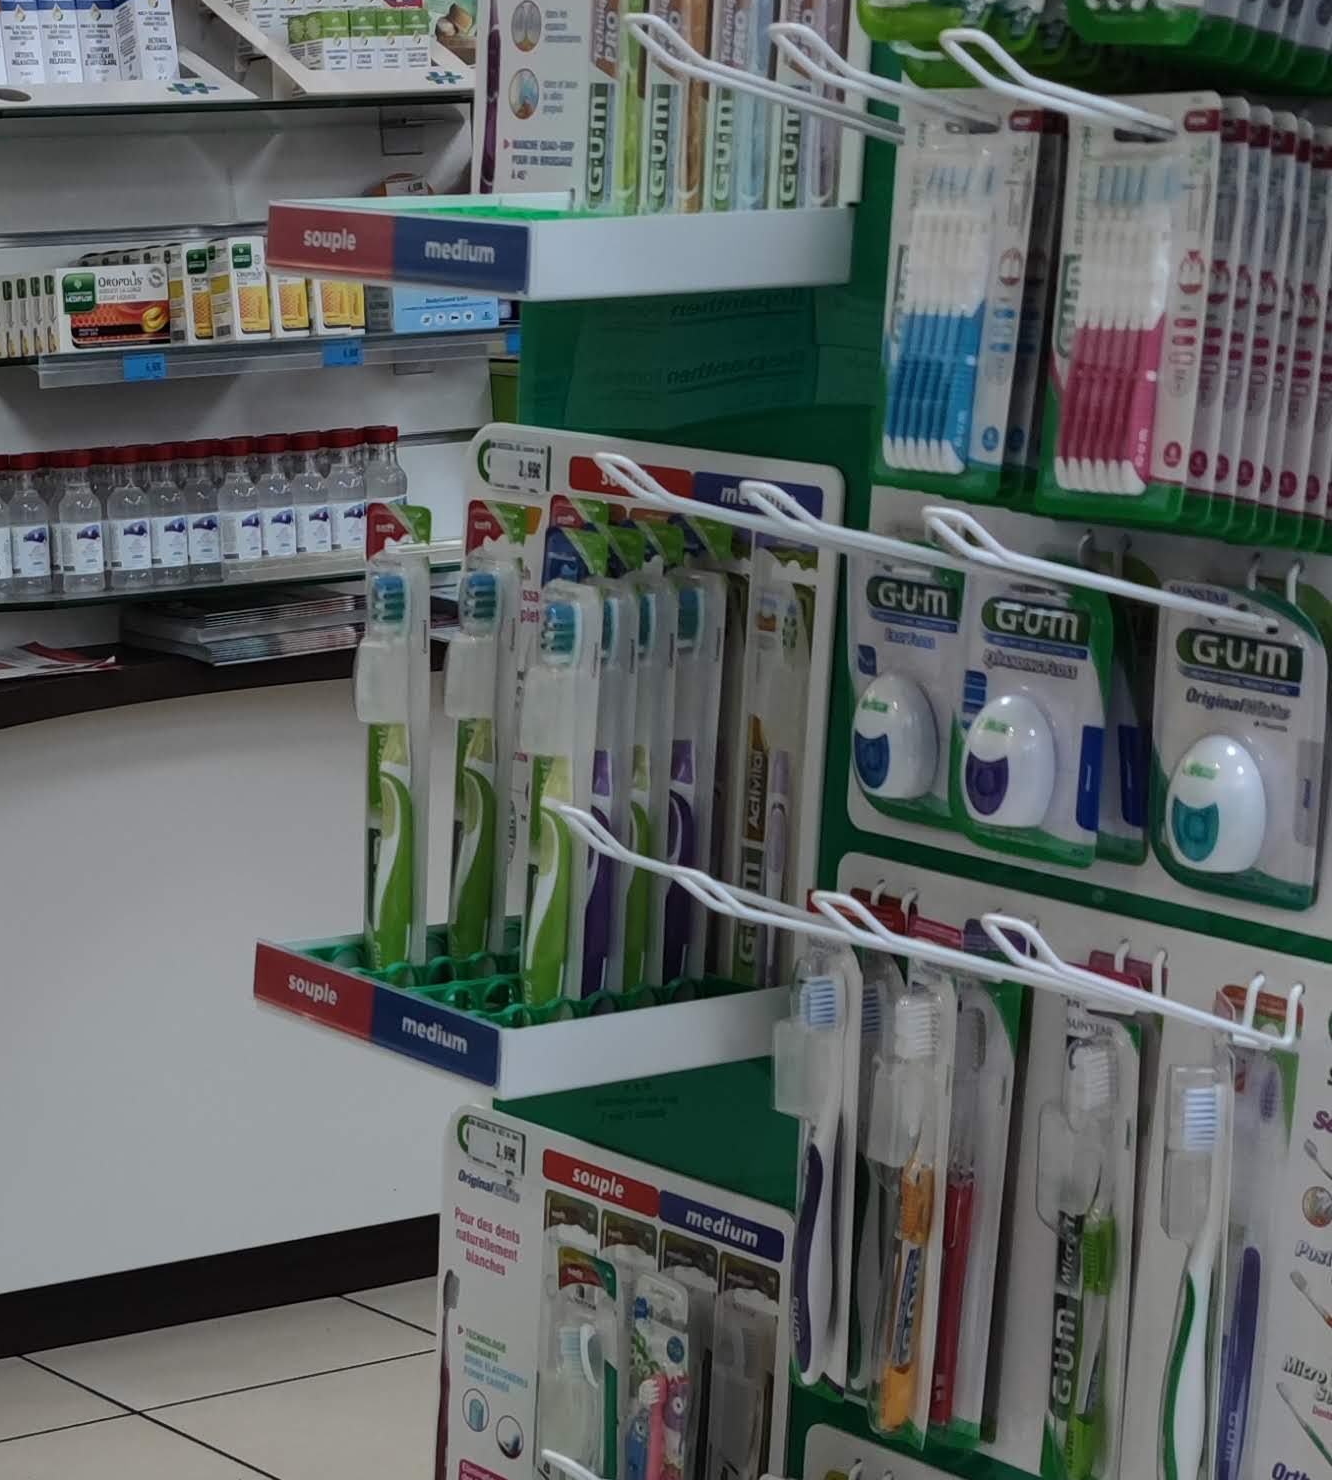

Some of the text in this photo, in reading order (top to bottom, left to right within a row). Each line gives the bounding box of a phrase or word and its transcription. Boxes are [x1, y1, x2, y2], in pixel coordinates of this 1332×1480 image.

[303, 228, 496, 265] souple medium
[288, 970, 468, 1054] souple medium
[455, 1206, 521, 1245] Pour des dents
[571, 1166, 759, 1249] souple medium
[456, 1228, 519, 1262] naturellement
[465, 1247, 506, 1276] blanches
